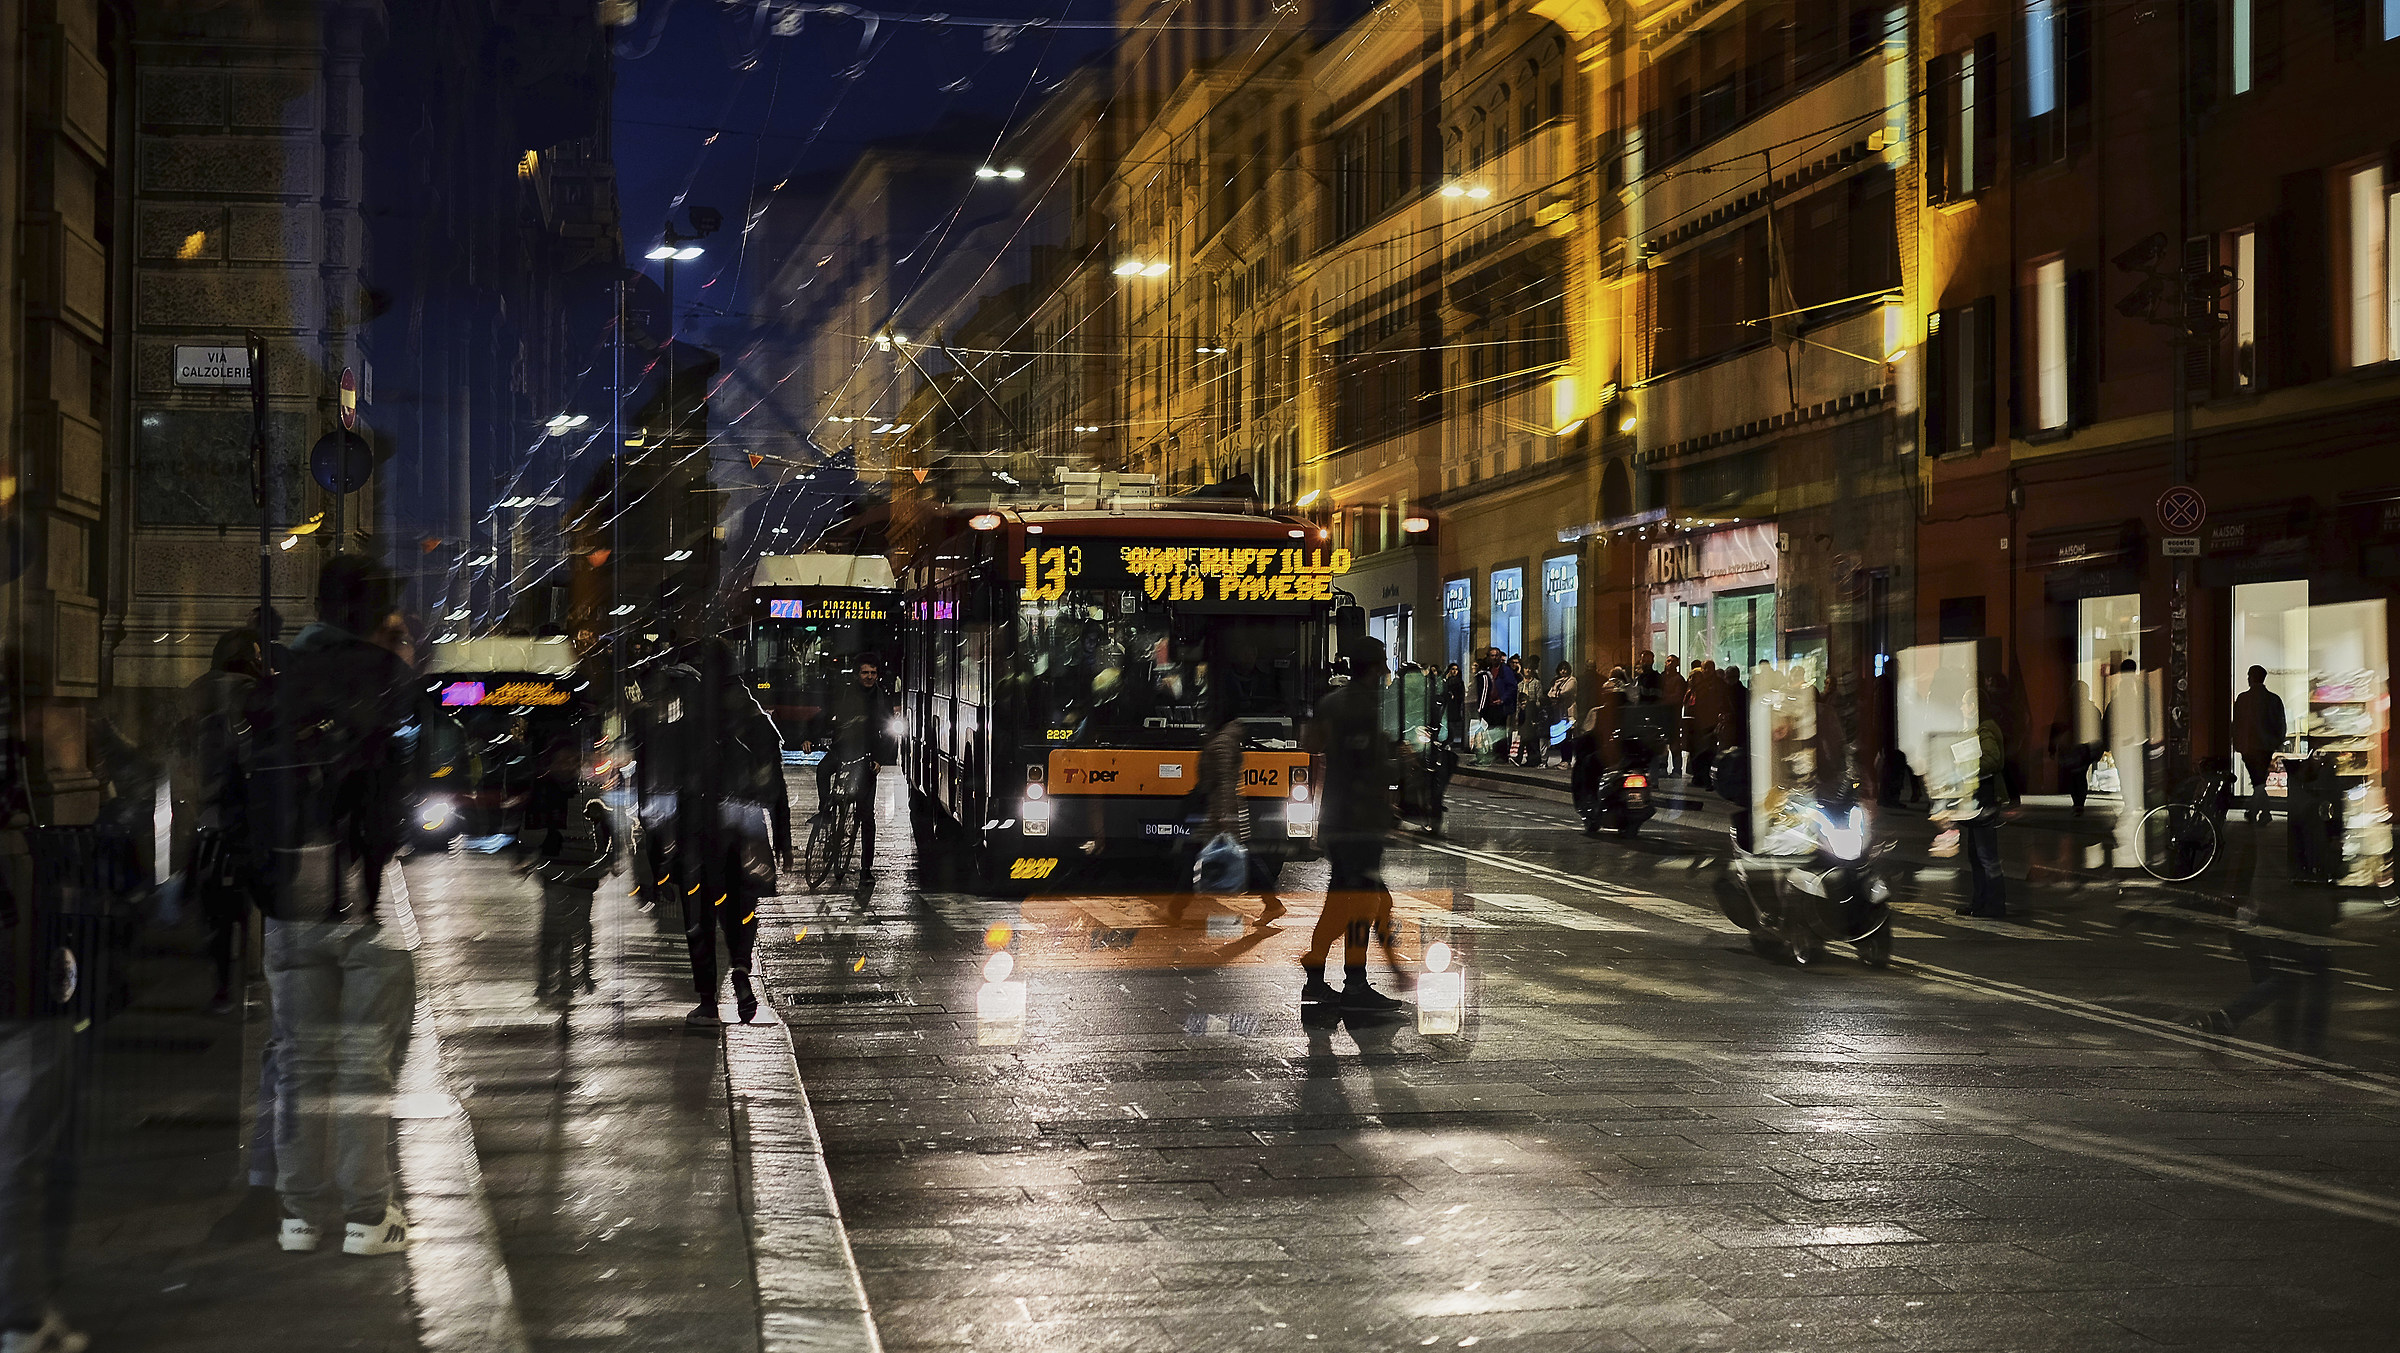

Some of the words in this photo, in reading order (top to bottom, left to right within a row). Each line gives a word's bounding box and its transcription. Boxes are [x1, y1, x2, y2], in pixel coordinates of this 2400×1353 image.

[208, 353, 227, 363] VIA
[2211, 524, 2245, 538] MAISONS
[2058, 543, 2086, 556] MAISONS
[1661, 543, 1699, 583] BNL
[1144, 575, 1204, 601] VIA
[1219, 575, 1334, 601] PAVESE
[823, 600, 871, 609] PIAZZALE
[806, 610, 840, 618] ATLETI
[845, 610, 887, 620] AZZURRI
[1046, 729, 1073, 740] 2237
[1243, 769, 1278, 786] 1042
